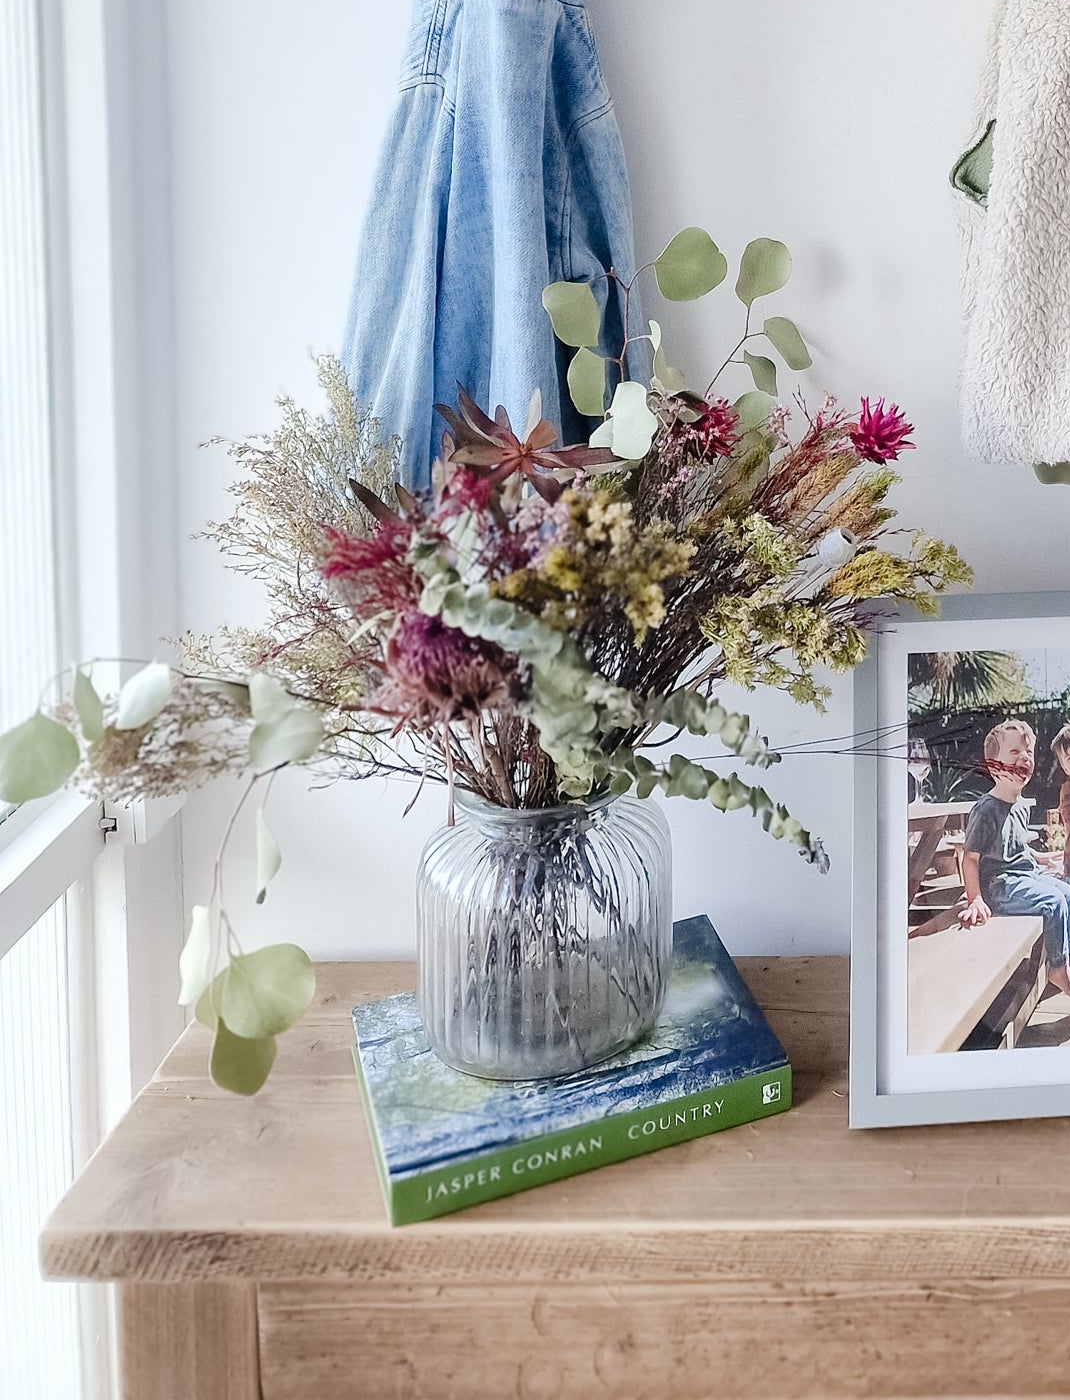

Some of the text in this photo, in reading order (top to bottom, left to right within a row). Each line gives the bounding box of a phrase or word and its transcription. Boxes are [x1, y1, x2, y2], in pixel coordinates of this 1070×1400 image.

[426, 1099, 726, 1203] JASPER CONRAN COUNTRY
